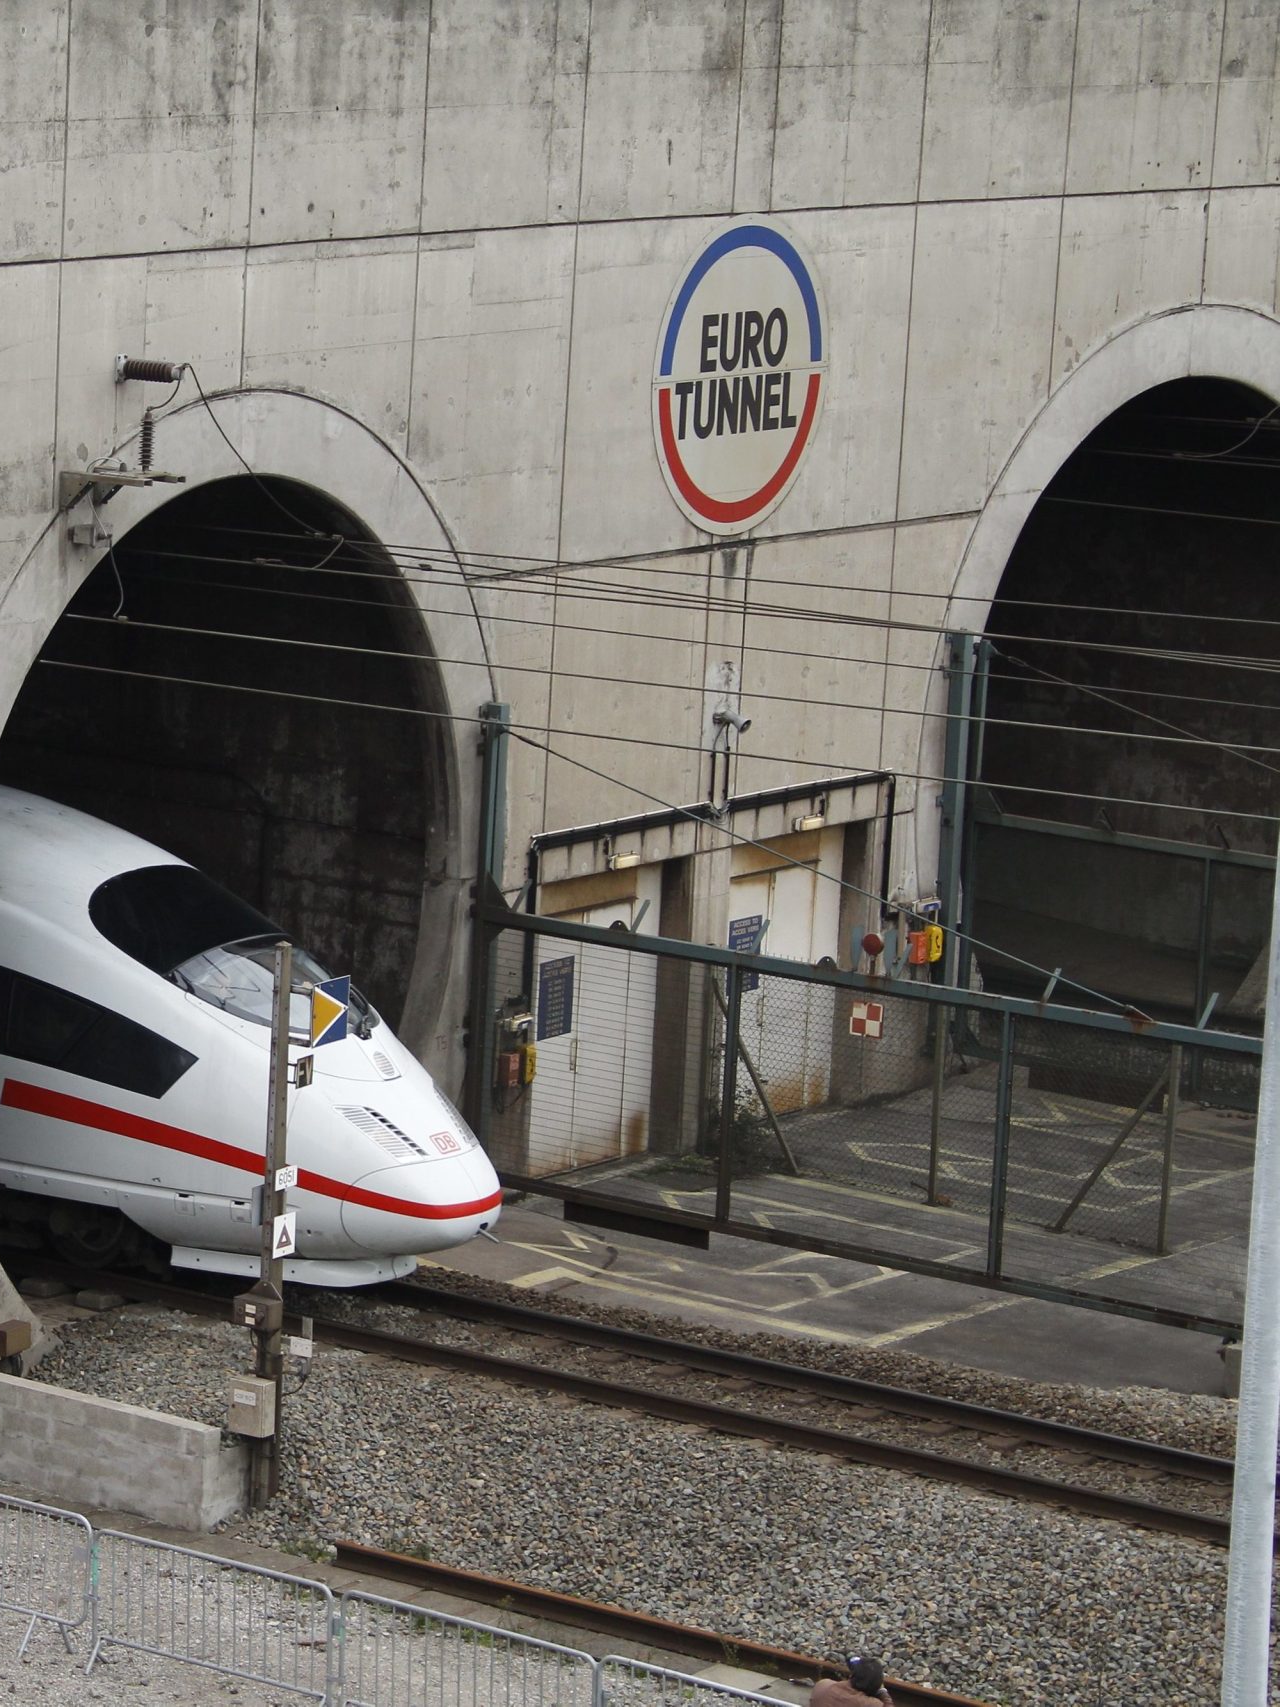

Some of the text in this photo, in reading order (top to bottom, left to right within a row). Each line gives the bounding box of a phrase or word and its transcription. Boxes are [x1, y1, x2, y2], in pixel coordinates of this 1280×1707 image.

[699, 307, 788, 373] EURO
[675, 371, 797, 441] TUNNEL
[432, 1133, 458, 1152] DB
